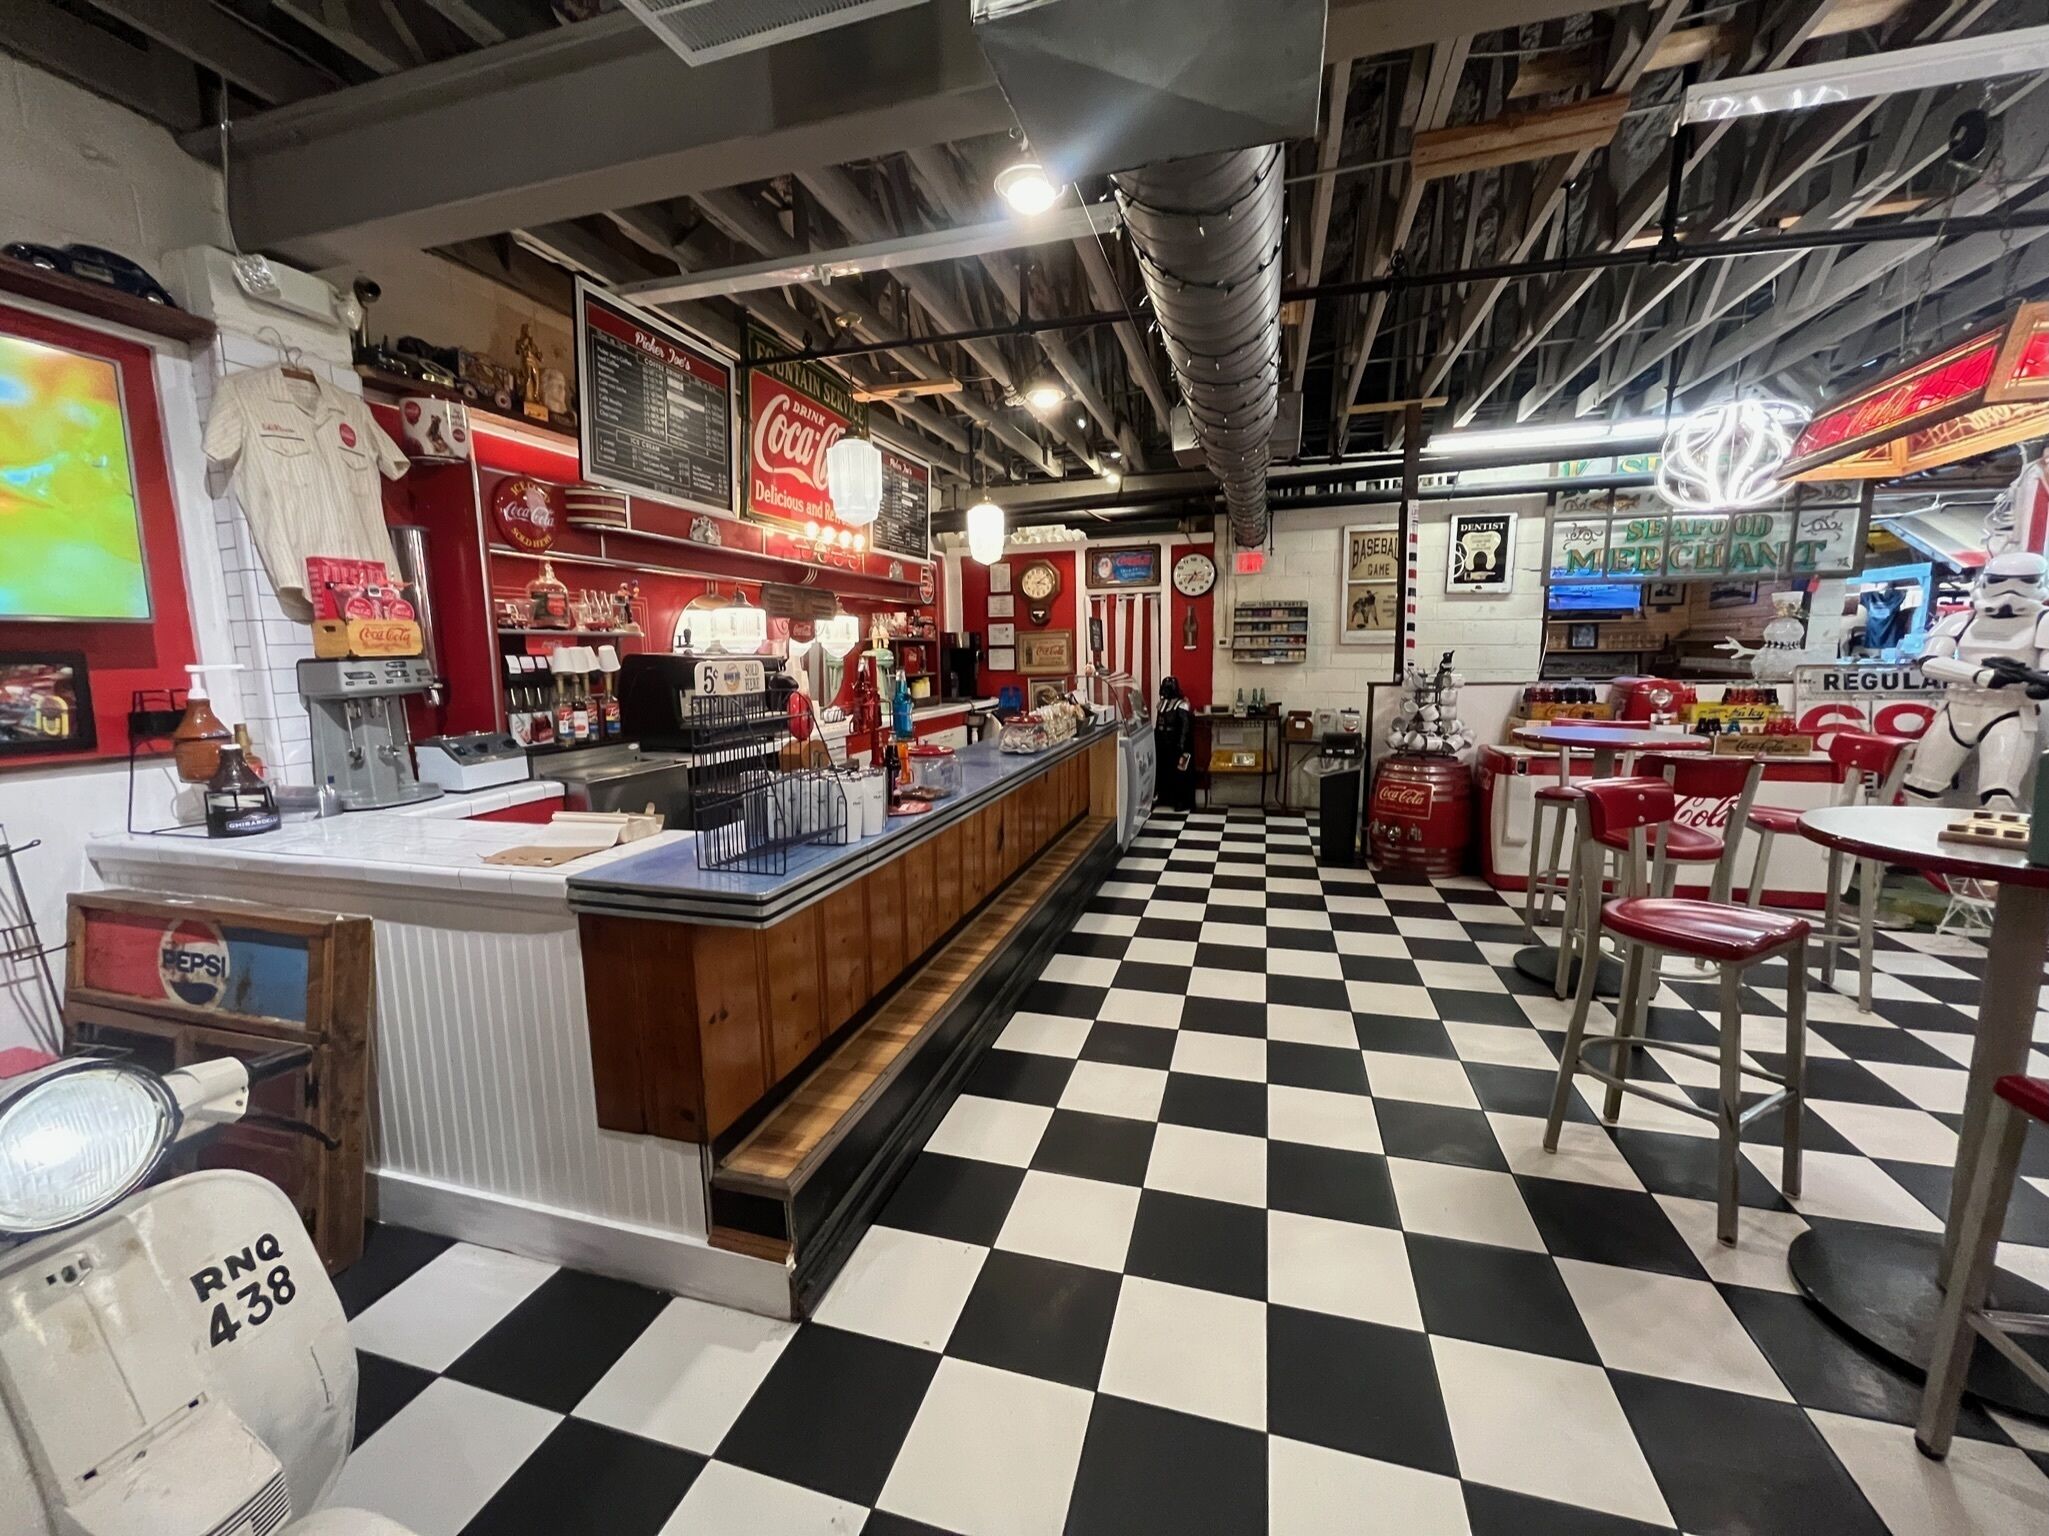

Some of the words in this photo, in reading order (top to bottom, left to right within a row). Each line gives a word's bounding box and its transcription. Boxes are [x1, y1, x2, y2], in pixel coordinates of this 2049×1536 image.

[635, 331, 664, 358] Picker
[668, 348, 691, 371] Joe's
[792, 400, 826, 427] DRINK
[755, 479, 804, 513] Delicious
[806, 501, 823, 519] and
[511, 527, 533, 549] SOLD
[1460, 522, 1506, 532] DENTIST
[1626, 514, 1774, 543] SEAFOOD
[1352, 537, 1399, 571] BASEBAL
[1566, 539, 1828, 576] MERCHANT
[1823, 671, 1949, 691] REGULA
[162, 948, 226, 978] PEPSI
[190, 1232, 283, 1302] RNQ
[209, 1265, 296, 1348] 438
